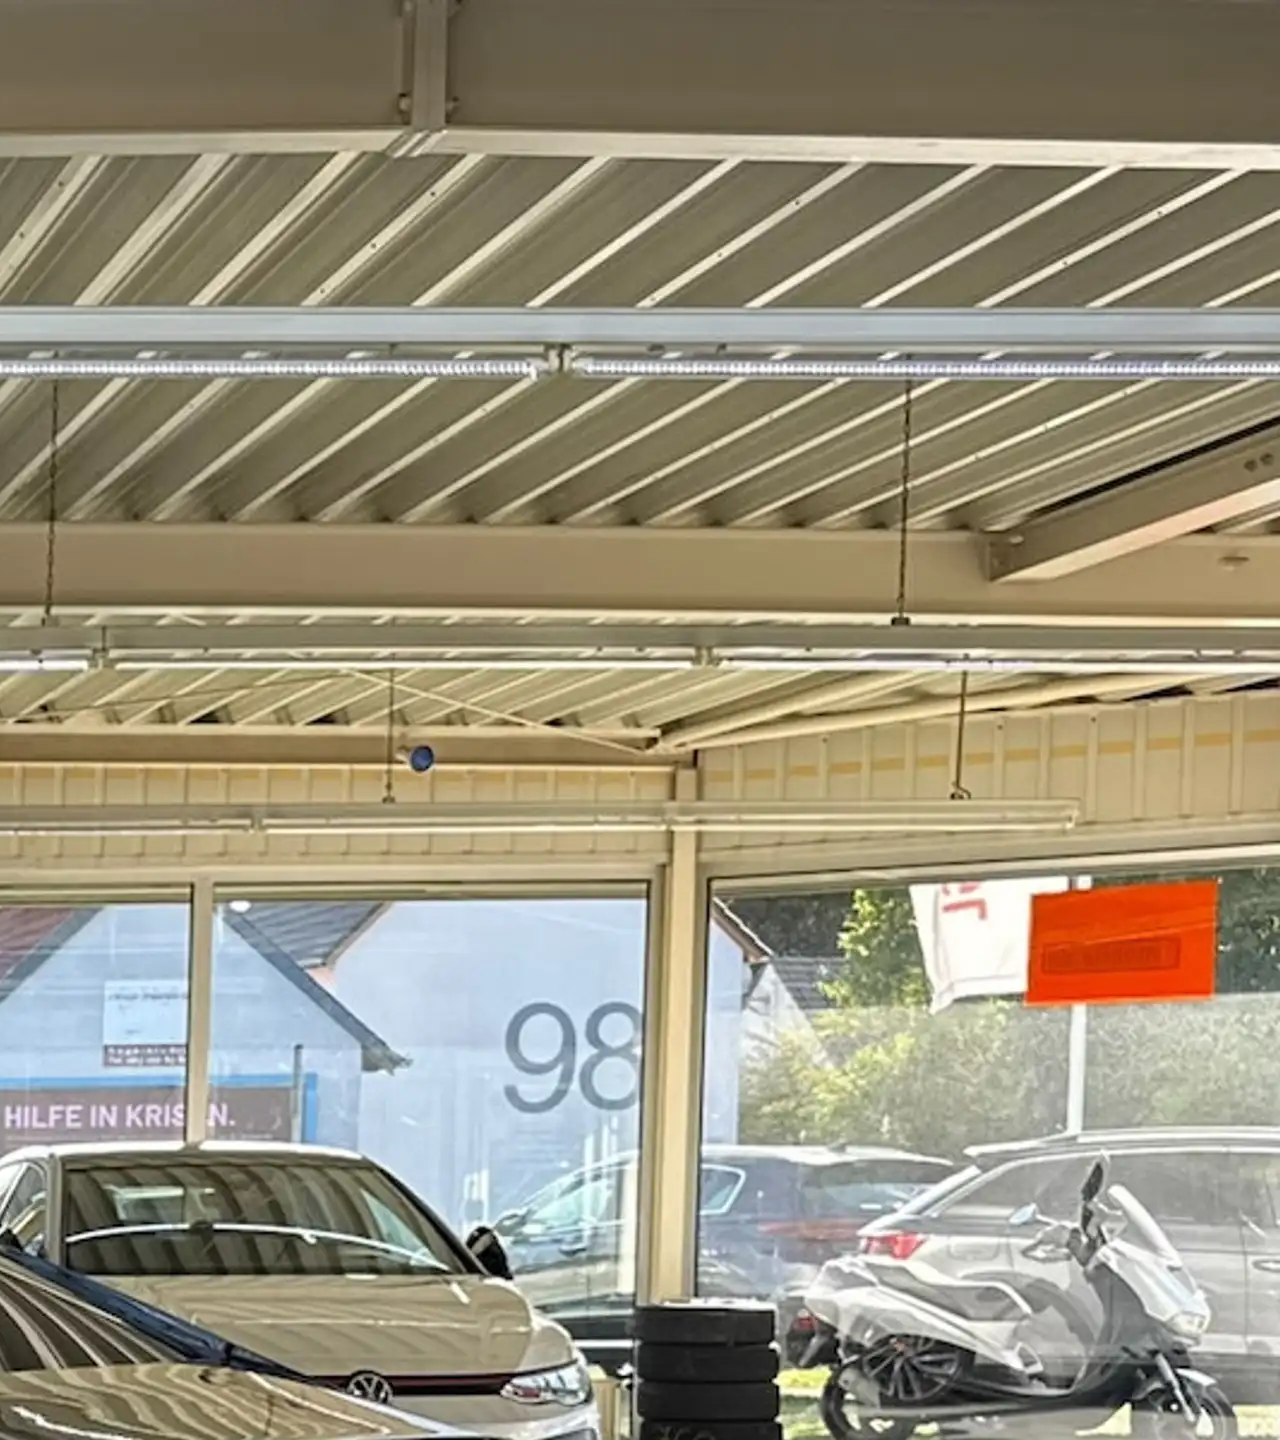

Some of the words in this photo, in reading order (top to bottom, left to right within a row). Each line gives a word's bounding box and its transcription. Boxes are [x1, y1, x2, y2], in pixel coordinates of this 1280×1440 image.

[504, 1002, 640, 1113] 98
[4, 1105, 83, 1128] HILFE
[91, 1104, 119, 1127] IN
[126, 1103, 236, 1128] KRISN.
